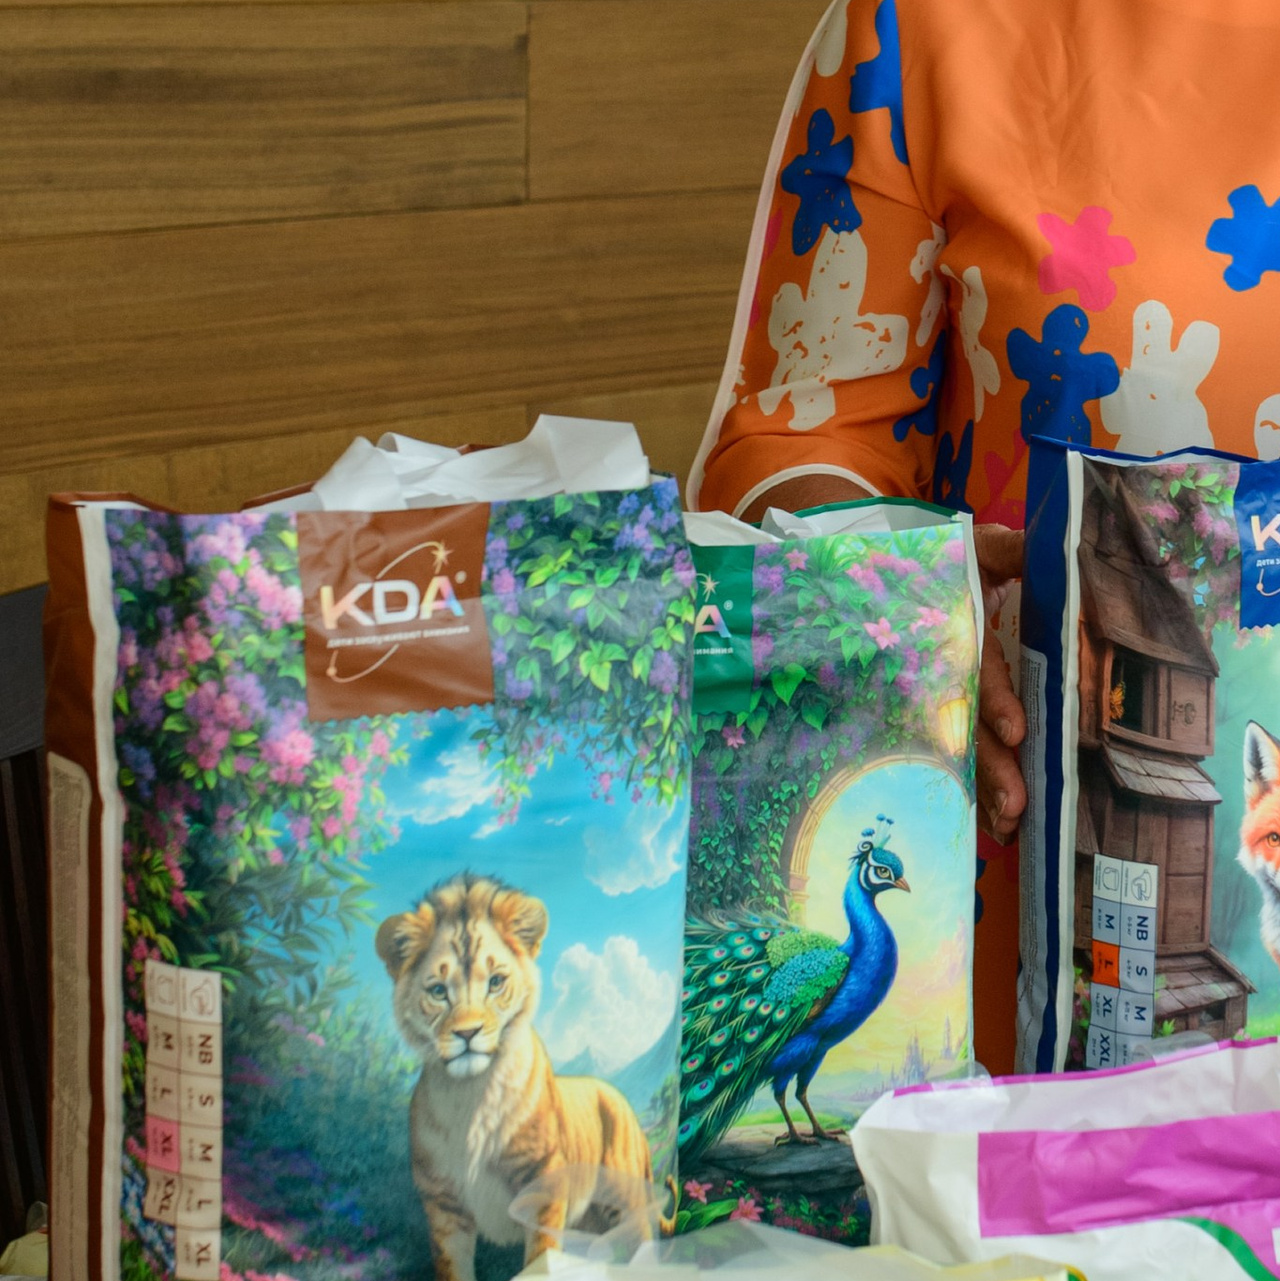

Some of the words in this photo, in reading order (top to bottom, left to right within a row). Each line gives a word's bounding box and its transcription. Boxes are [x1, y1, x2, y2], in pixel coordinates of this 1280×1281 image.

[319, 574, 466, 631] KDA
[1105, 914, 1115, 930] M
[1136, 915, 1149, 941] NB
[1104, 959, 1114, 969] L
[1135, 965, 1148, 977] S
[1103, 995, 1113, 1018] XL
[1134, 1005, 1147, 1022] M
[162, 1033, 174, 1050] M
[199, 1033, 214, 1065] NB
[1099, 1033, 1111, 1066] XXL
[160, 1088, 172, 1098] L
[199, 1094, 214, 1107] S
[161, 1131, 173, 1156] XL
[199, 1143, 214, 1162] M
[158, 1176, 175, 1214] XXL
[198, 1198, 212, 1210] L
[197, 1242, 212, 1267] XL
